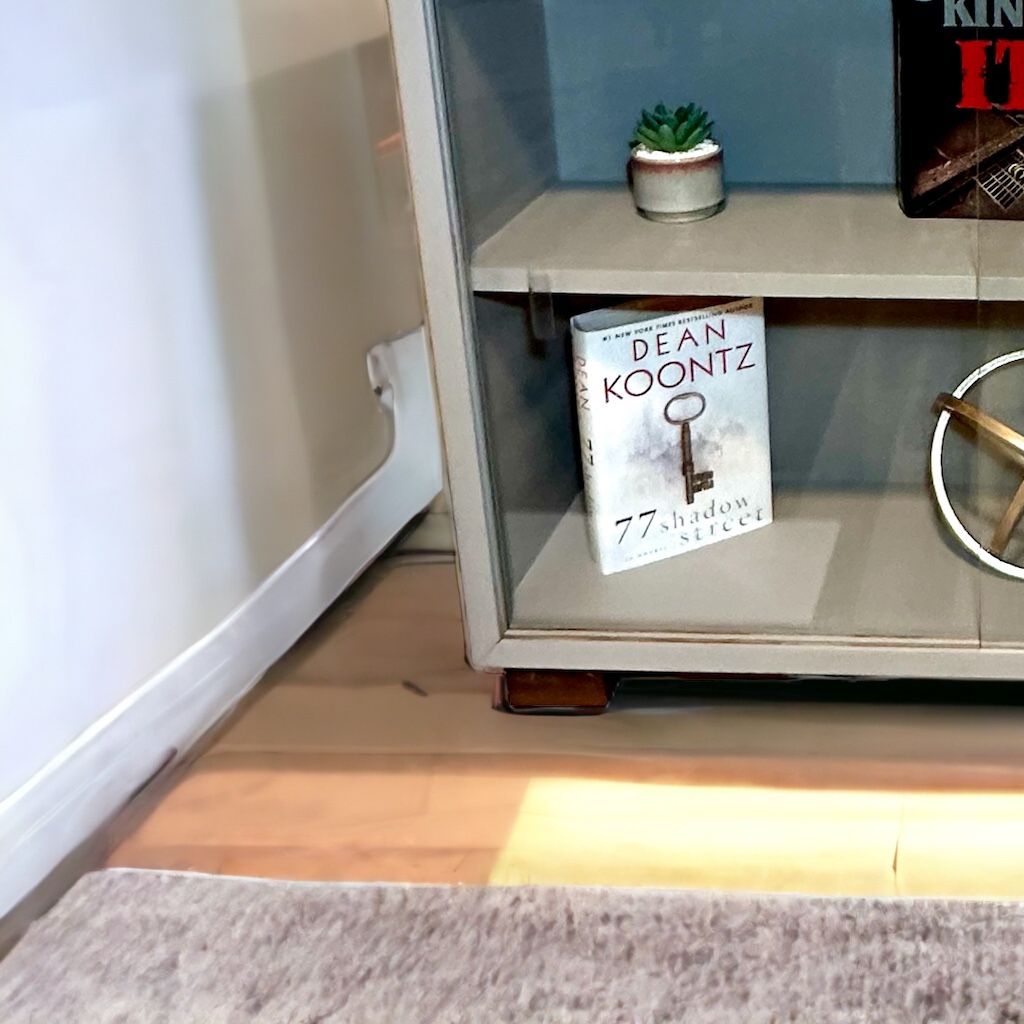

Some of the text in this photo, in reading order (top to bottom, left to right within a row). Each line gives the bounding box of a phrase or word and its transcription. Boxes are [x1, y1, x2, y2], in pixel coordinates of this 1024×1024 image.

[615, 331, 632, 339] NEW
[634, 325, 653, 335] YORK
[656, 321, 676, 330] TIMES
[633, 319, 725, 361] DEAN
[575, 356, 591, 411] DEAN
[604, 343, 756, 403] KOONTZ
[615, 497, 749, 545] 77 shadow
[680, 508, 764, 546] street
